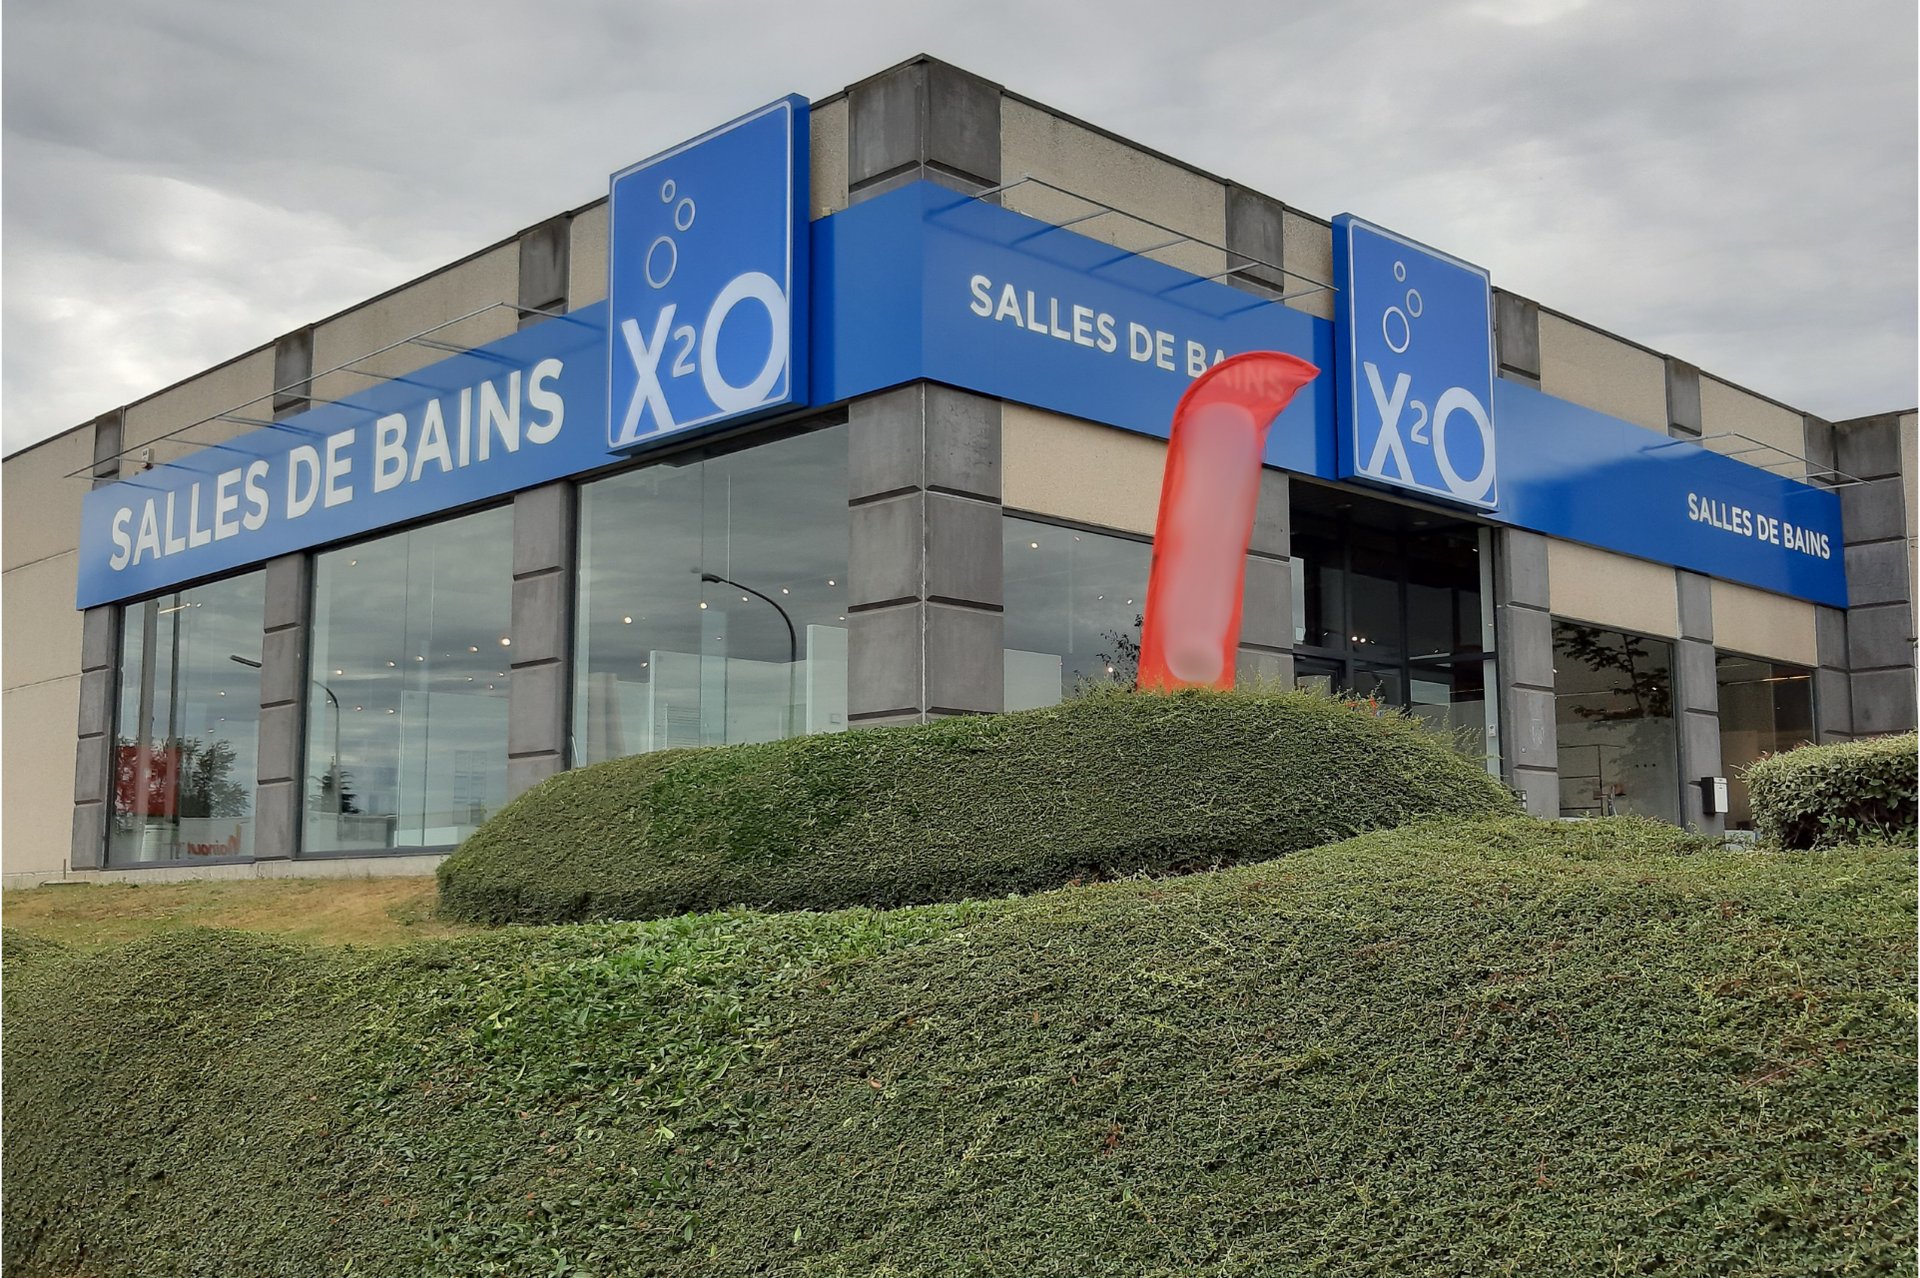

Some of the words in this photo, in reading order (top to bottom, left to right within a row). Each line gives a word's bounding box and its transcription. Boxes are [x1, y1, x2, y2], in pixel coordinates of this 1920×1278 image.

[970, 274, 1118, 353] SALLES
[1129, 321, 1176, 372] DE
[108, 459, 271, 572] SALLES
[286, 428, 357, 520] DE
[372, 358, 566, 494] BAINS
[1687, 492, 1753, 537] SALLES
[1756, 514, 1780, 545] DE
[1783, 522, 1831, 560] BAINS
